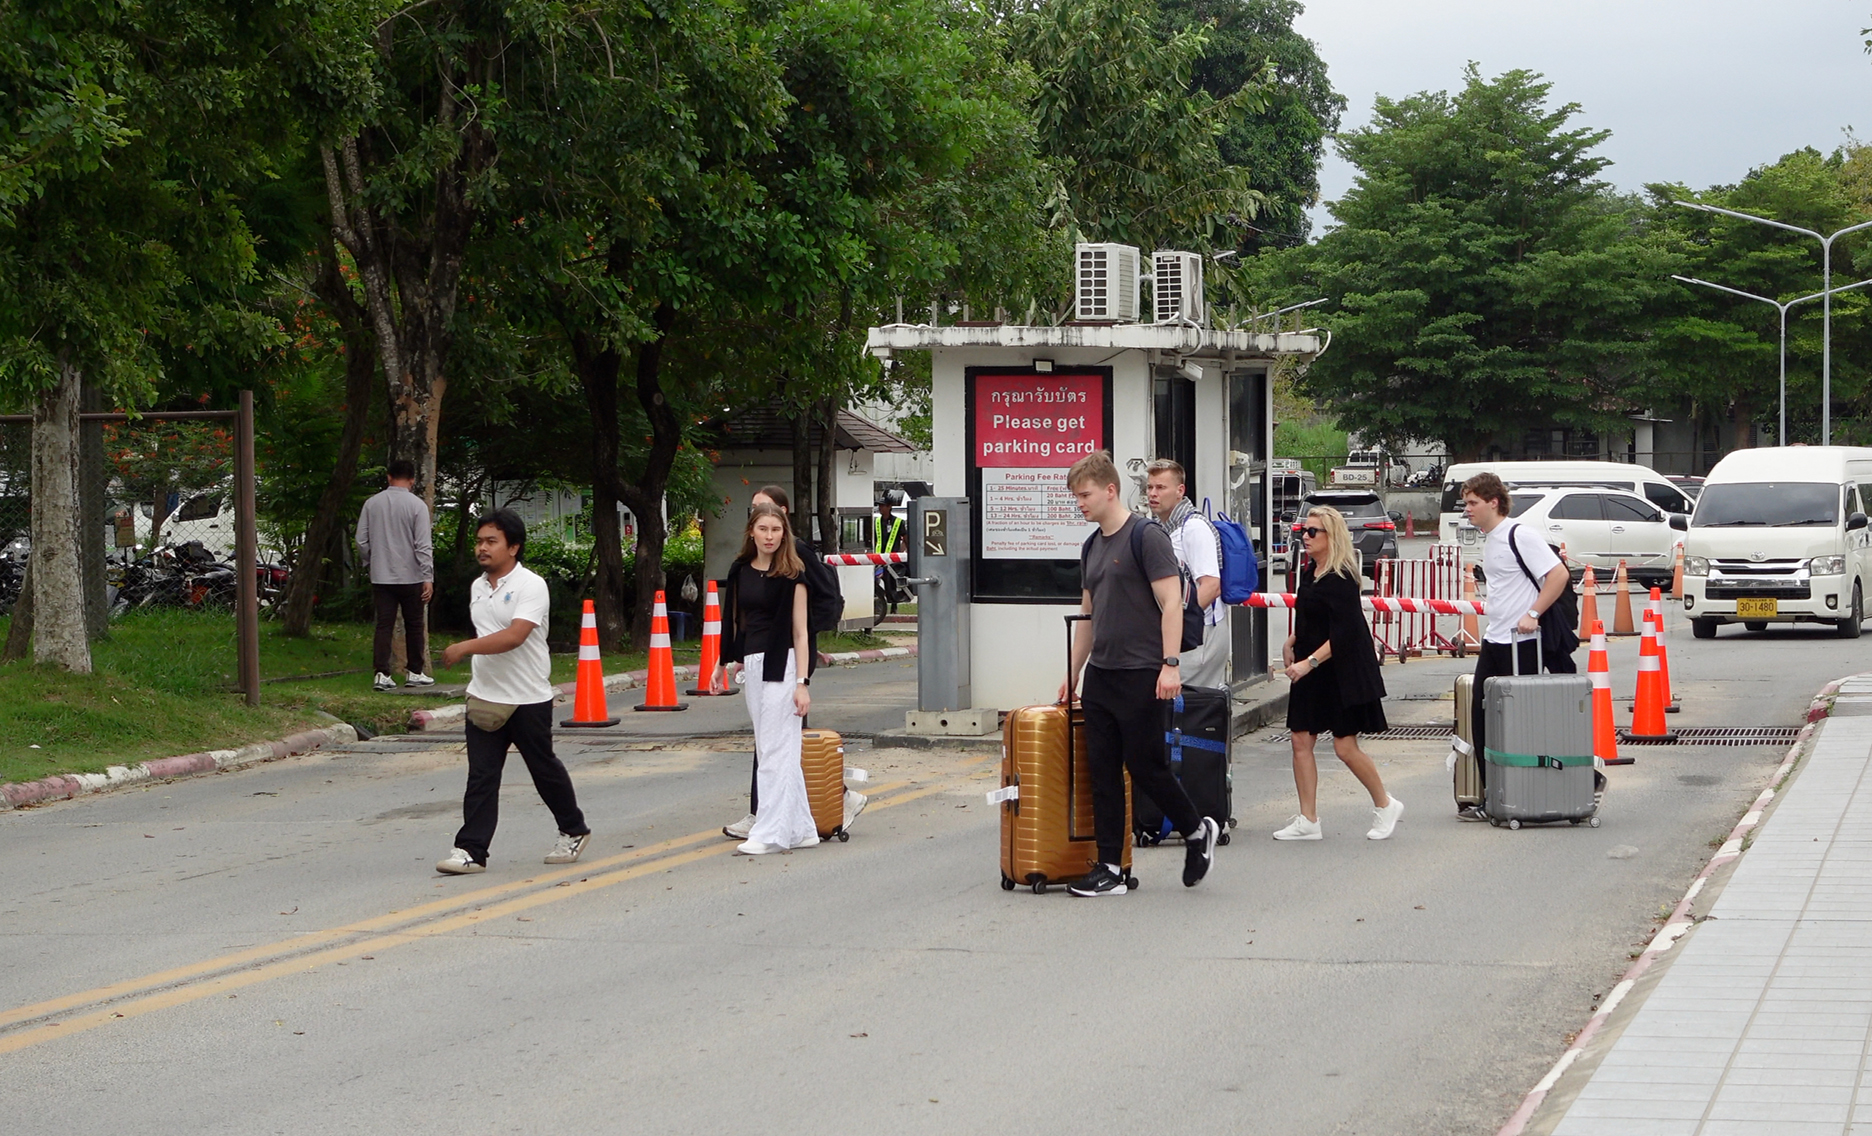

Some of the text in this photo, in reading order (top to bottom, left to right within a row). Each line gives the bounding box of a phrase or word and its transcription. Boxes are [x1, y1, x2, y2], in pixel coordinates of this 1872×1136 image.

[991, 386, 1087, 408] กรุณารับบัตร
[993, 414, 1086, 432] Please get
[983, 439, 1095, 457] parking card
[1005, 473, 1036, 482] Parking
[925, 511, 941, 537] P
[1740, 602, 1774, 612] 30-1480
